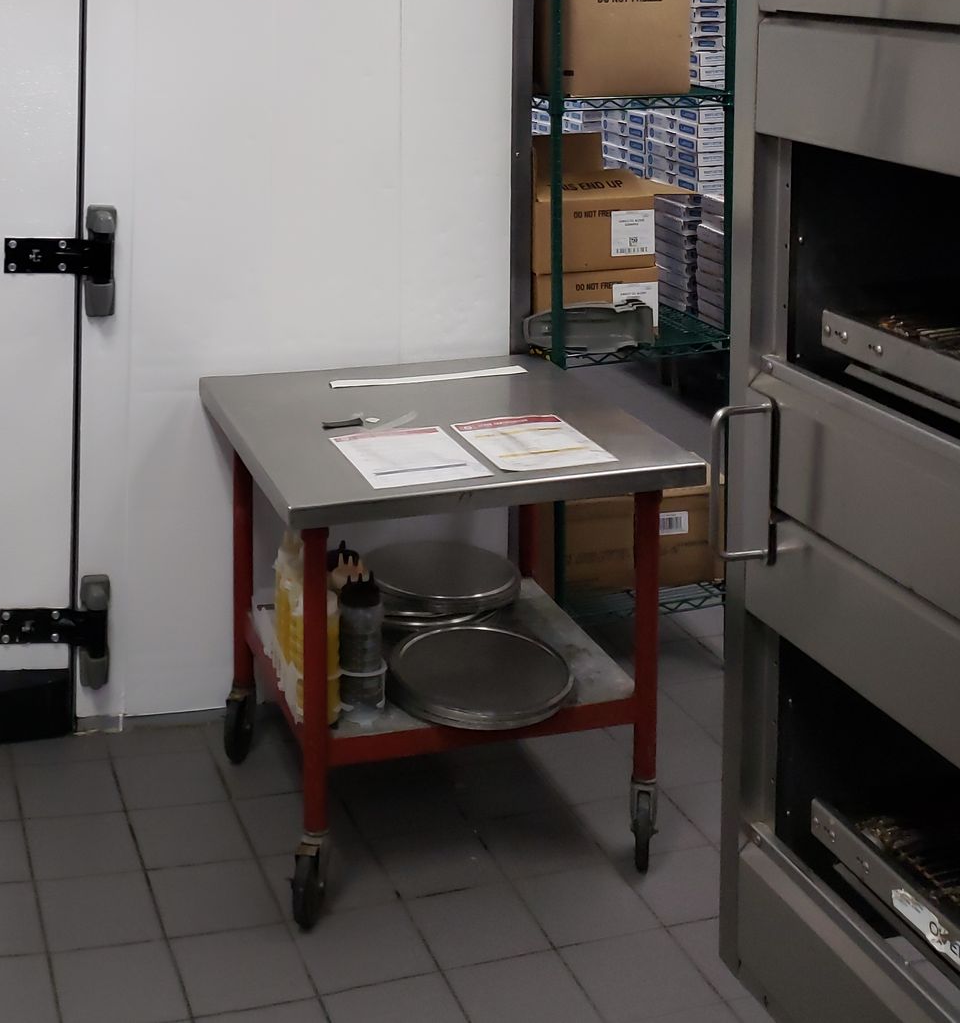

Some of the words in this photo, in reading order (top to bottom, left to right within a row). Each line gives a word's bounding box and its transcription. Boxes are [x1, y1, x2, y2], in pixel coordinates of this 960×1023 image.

[579, 181, 605, 190] END
[606, 179, 623, 189] UP
[573, 211, 583, 219] DO
[584, 210, 597, 218] NOT
